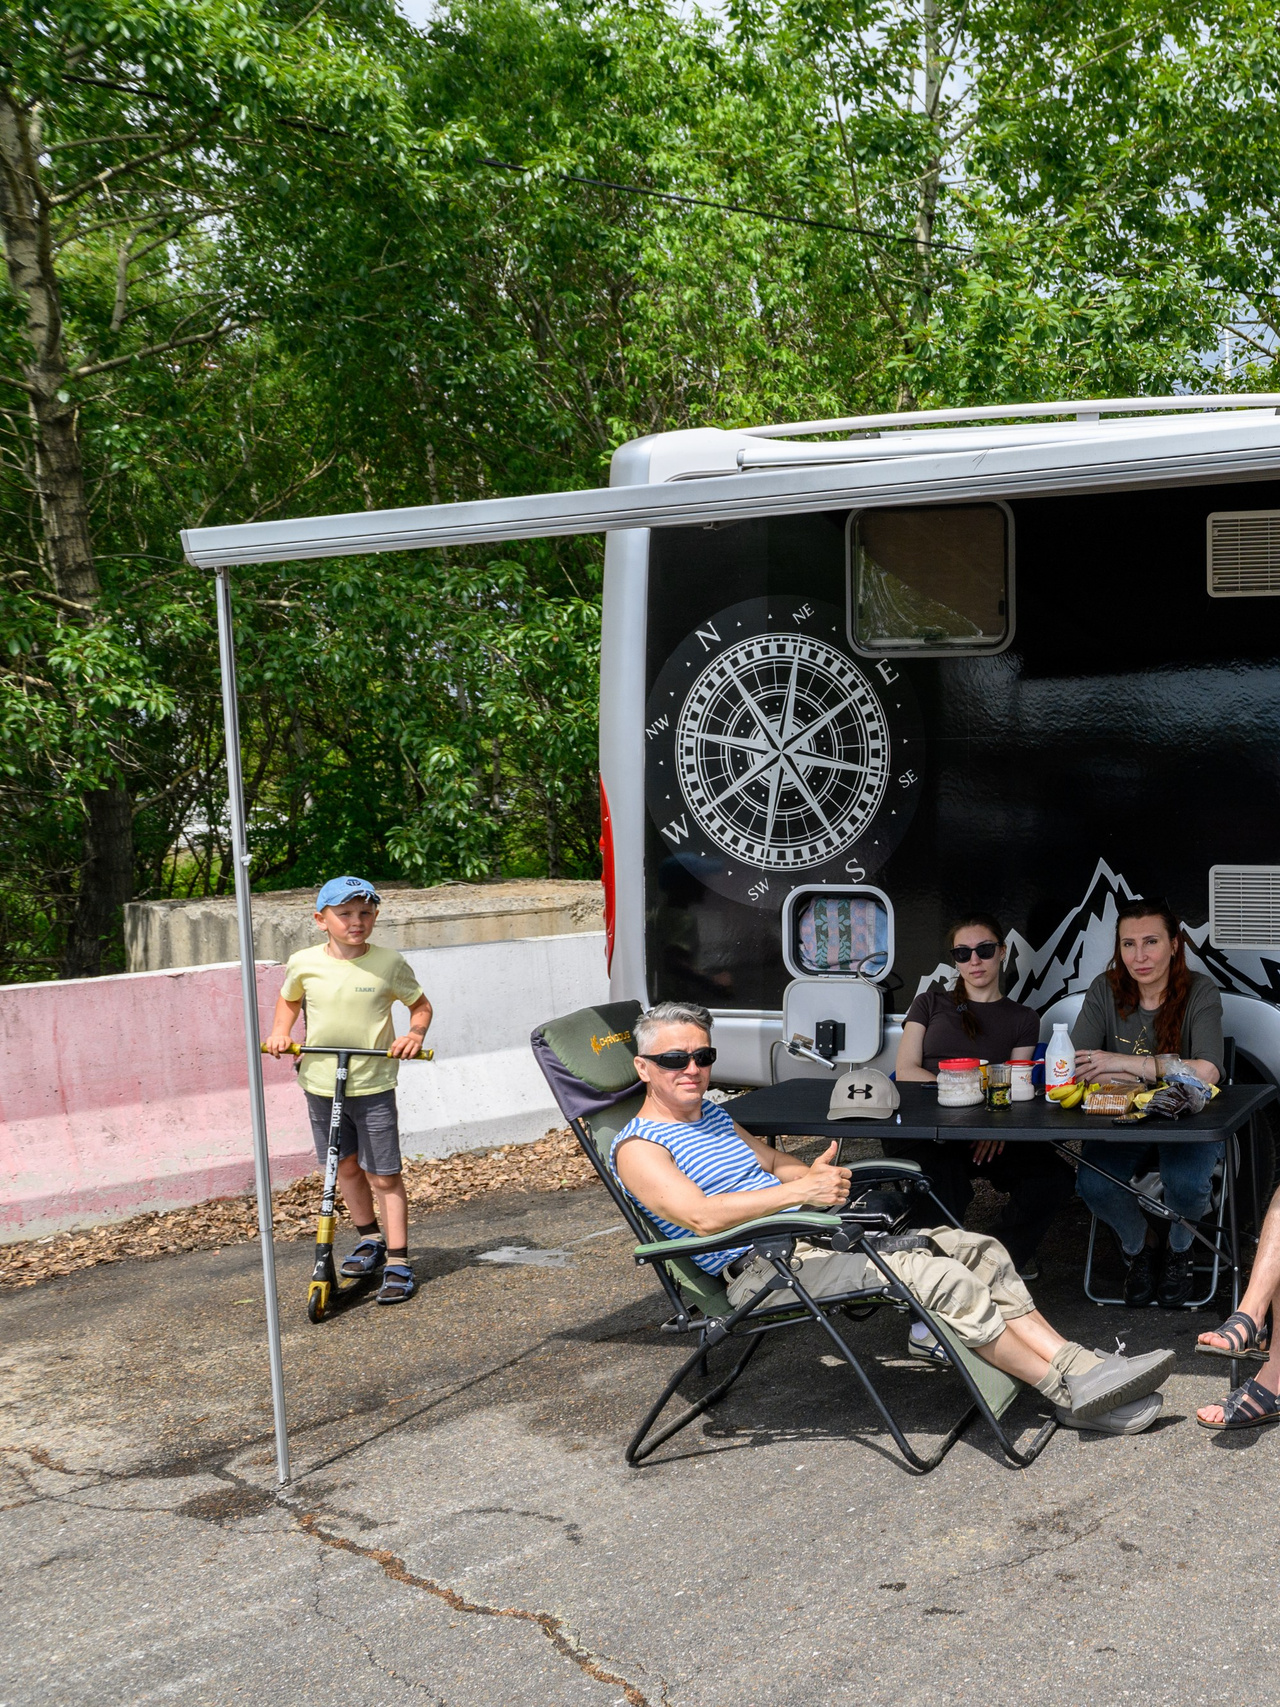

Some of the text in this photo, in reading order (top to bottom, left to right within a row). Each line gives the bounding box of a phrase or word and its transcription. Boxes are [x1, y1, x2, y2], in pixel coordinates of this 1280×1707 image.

[792, 603, 815, 625] NE
[695, 621, 721, 652] N
[875, 658, 899, 685] E
[645, 713, 669, 740] NW
[898, 769, 918, 789] SE
[661, 813, 689, 846] W
[845, 858, 866, 883] S
[747, 877, 770, 901] SW
[331, 1102, 342, 1128] RUSH
